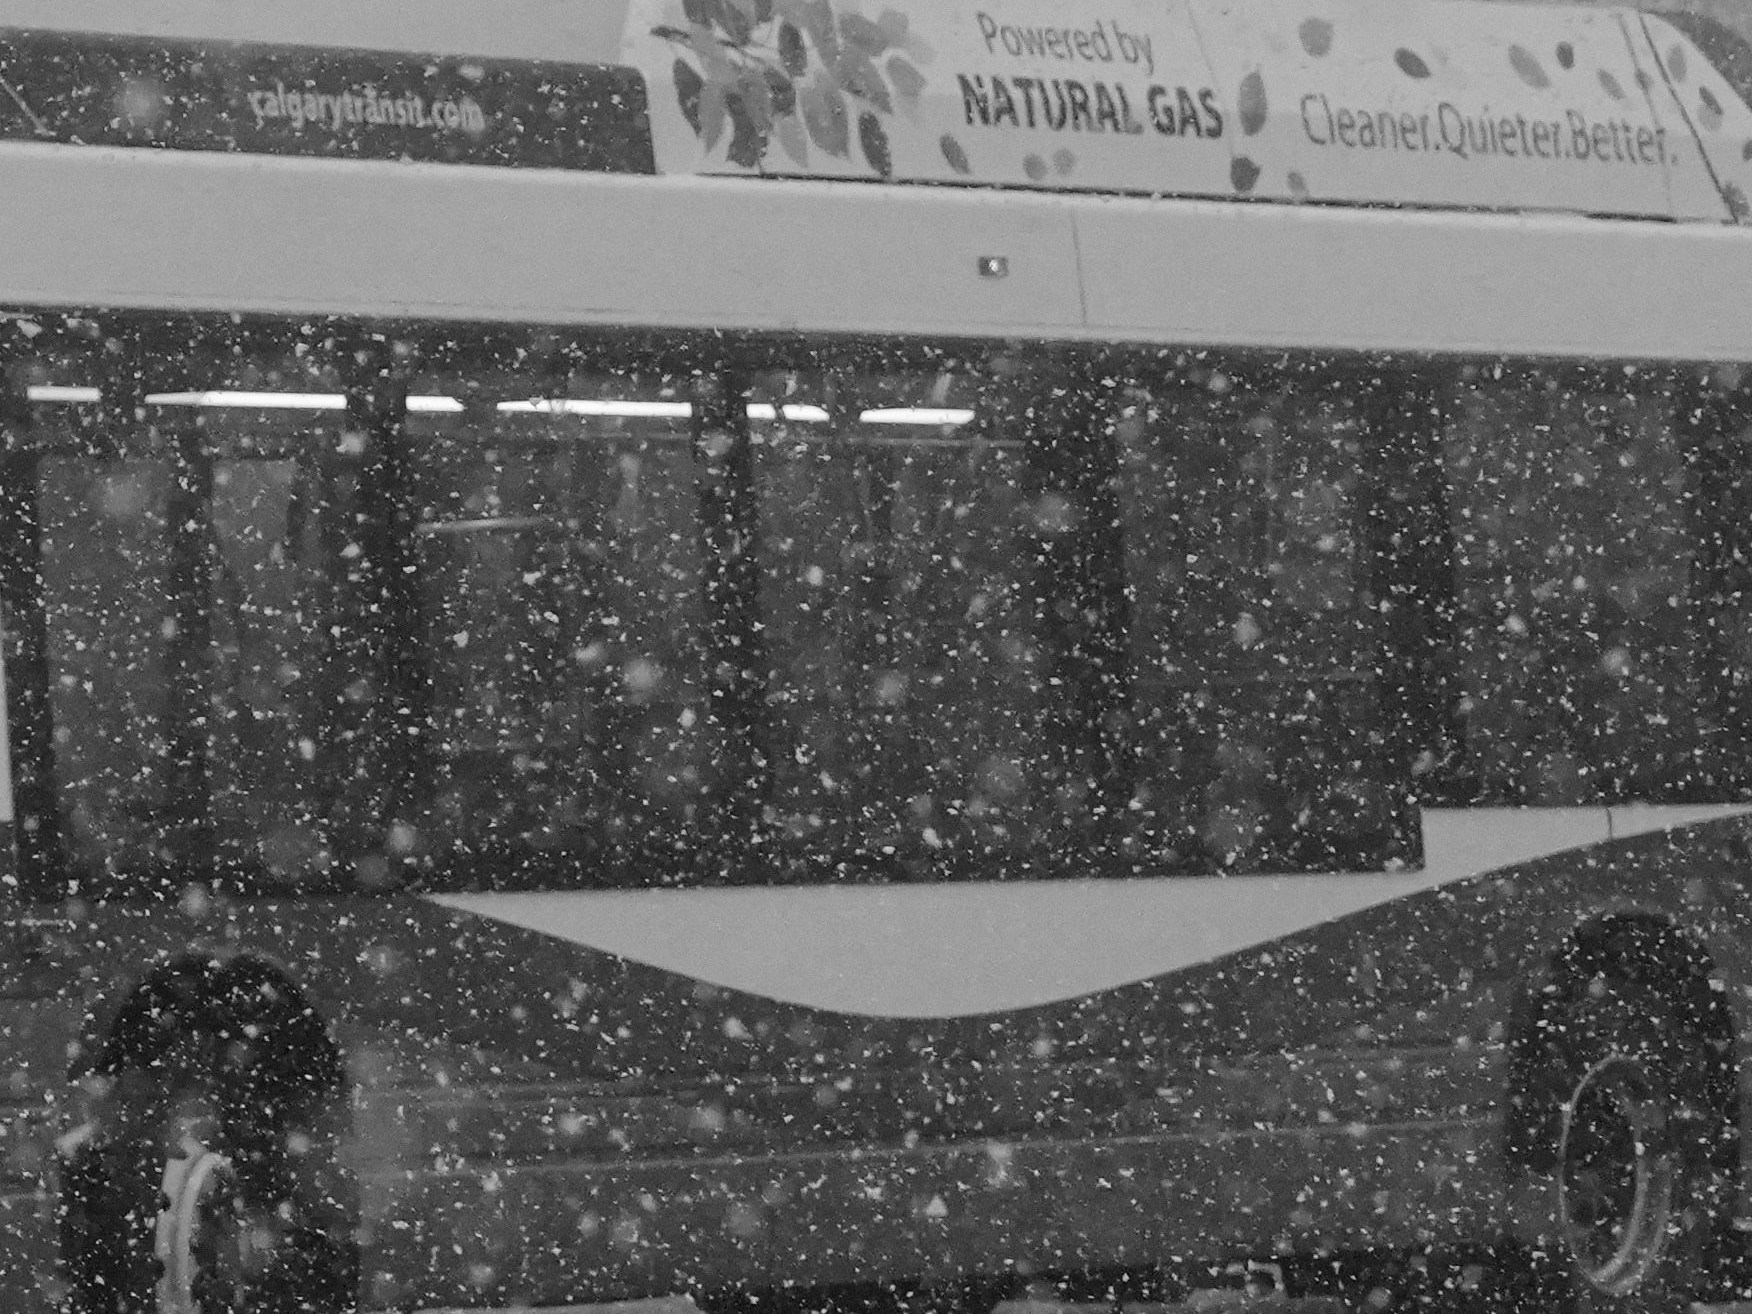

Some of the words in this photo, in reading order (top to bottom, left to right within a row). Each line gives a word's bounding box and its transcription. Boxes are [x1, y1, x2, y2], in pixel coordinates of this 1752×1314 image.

[976, 11, 1113, 64] Powered
[1111, 19, 1154, 77] by
[957, 73, 1143, 134] NATURAL
[1148, 85, 1224, 139] GAS
